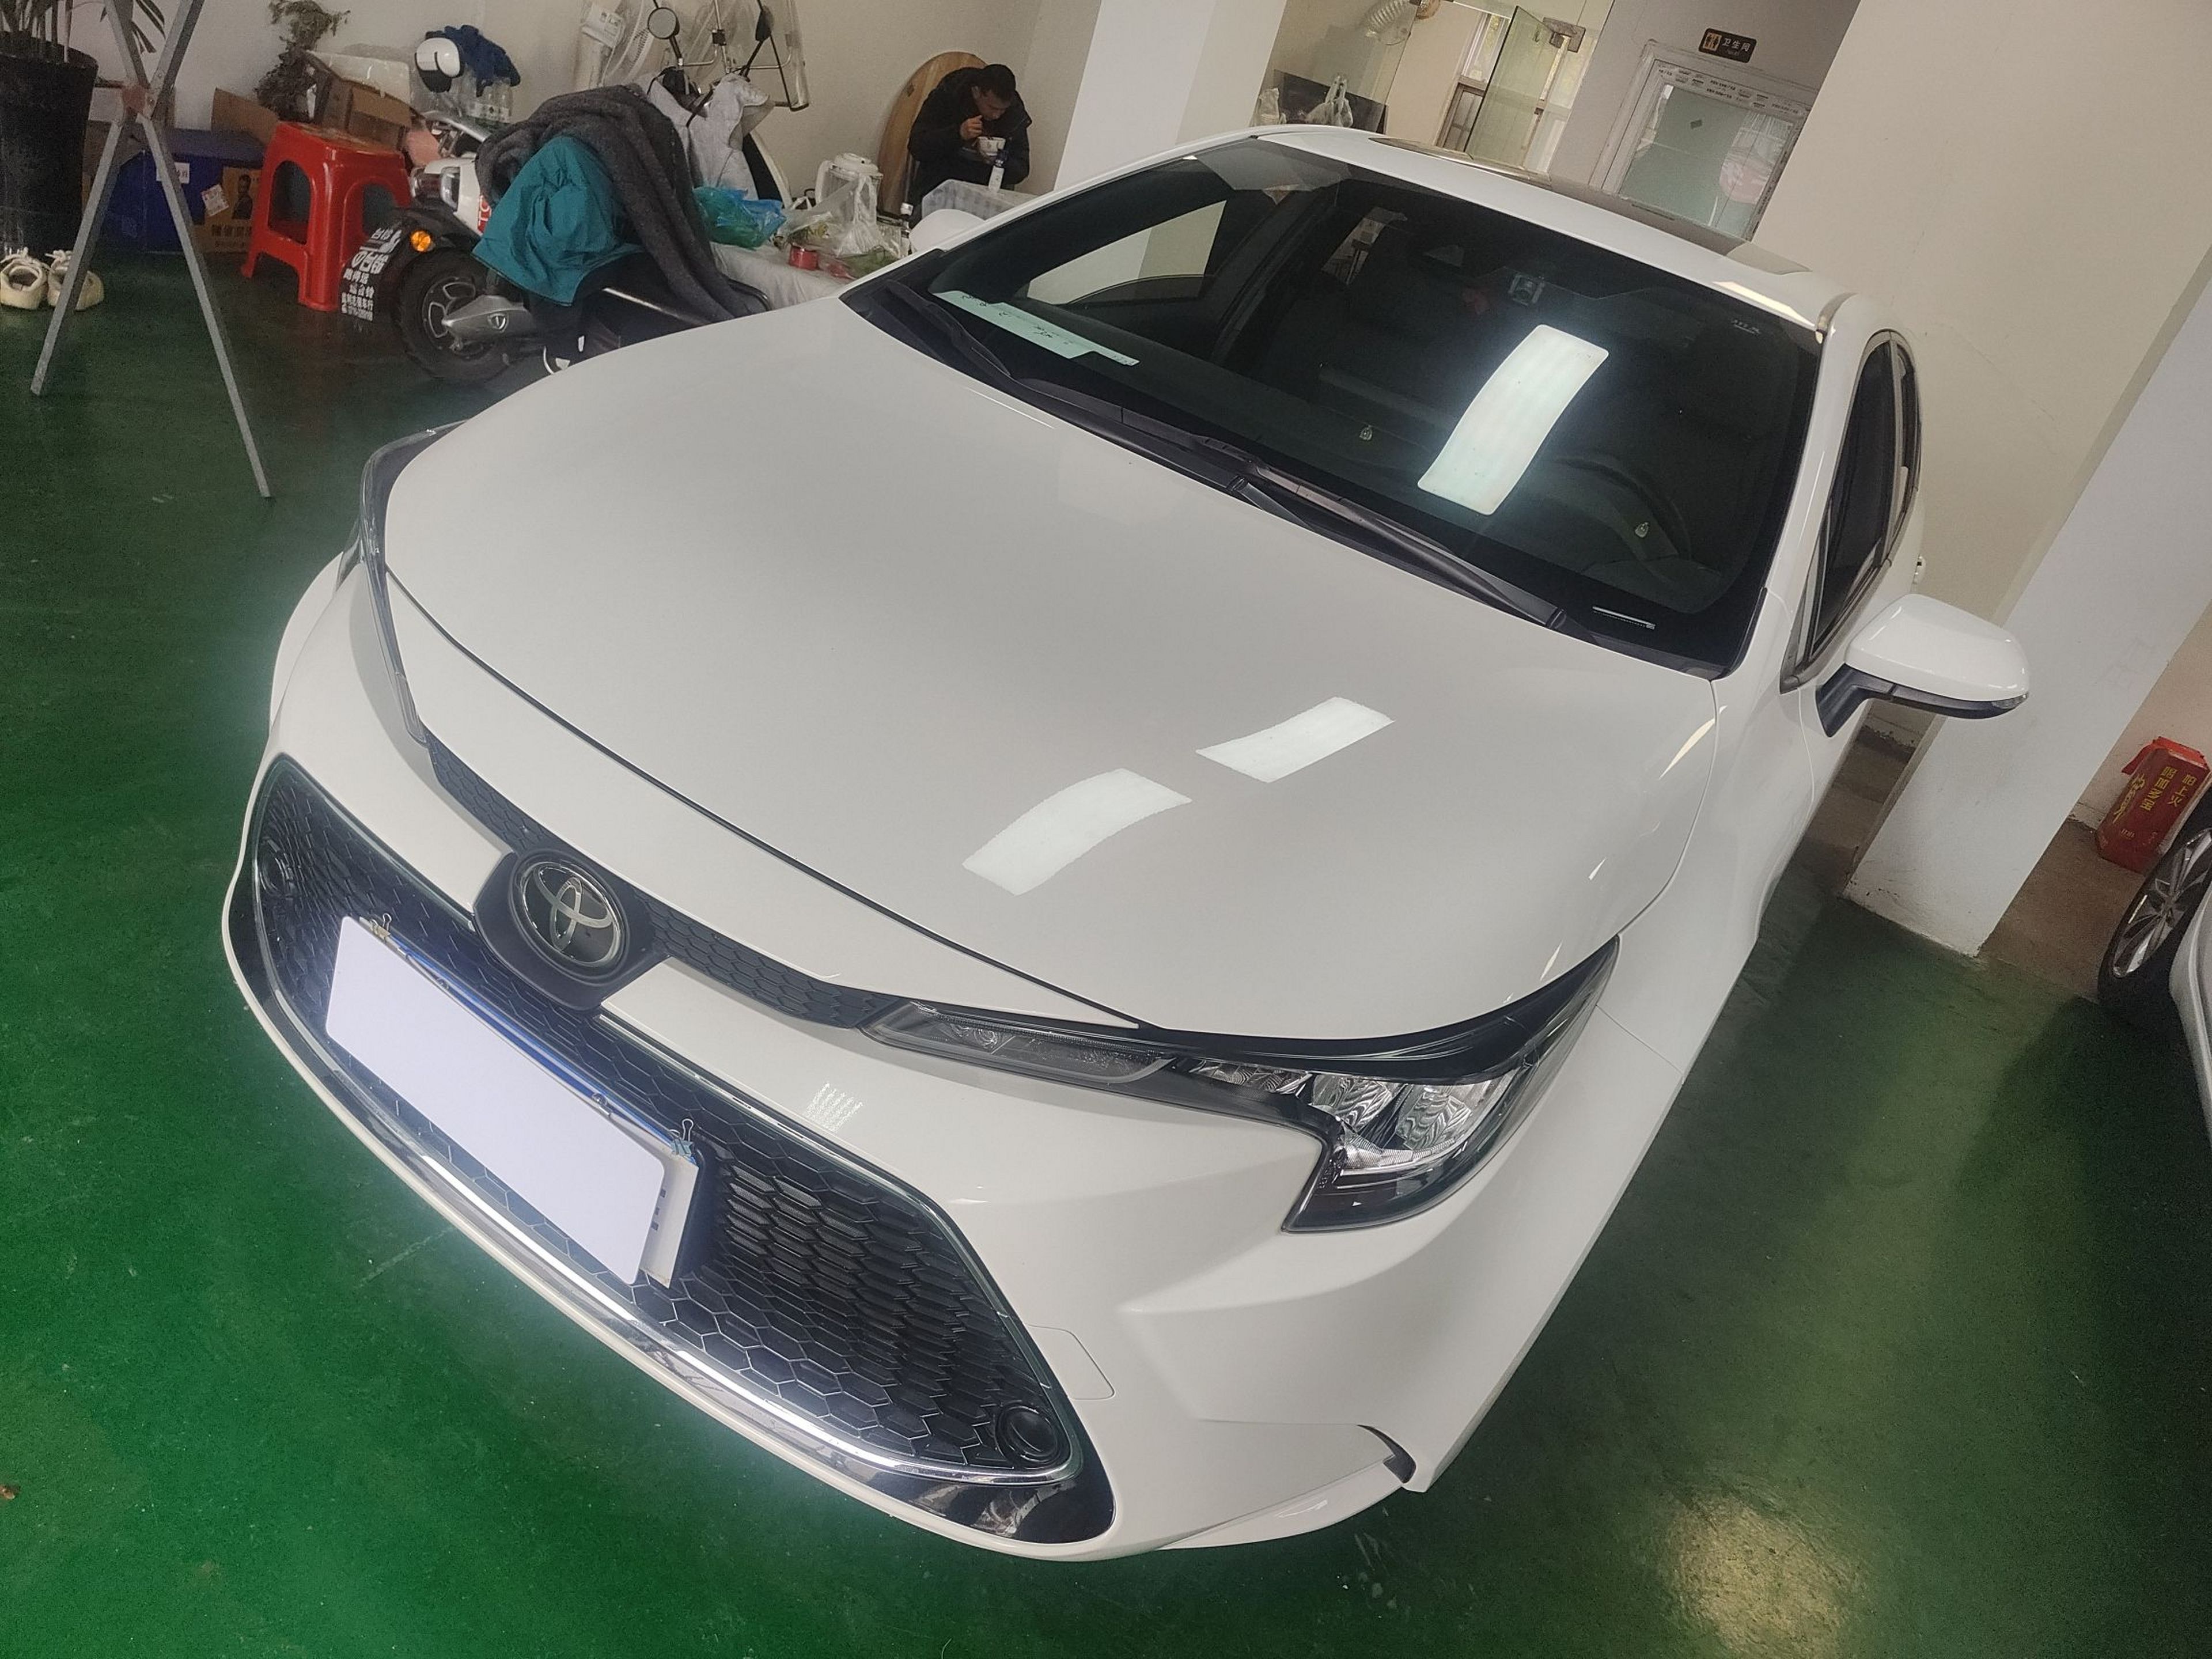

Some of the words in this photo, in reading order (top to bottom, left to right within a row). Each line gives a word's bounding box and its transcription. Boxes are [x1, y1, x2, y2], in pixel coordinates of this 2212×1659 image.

[1722, 38, 1751, 52] 卫生间
[2140, 766, 2177, 811] 喝加多宝
[2166, 774, 2197, 807] 怕上火
